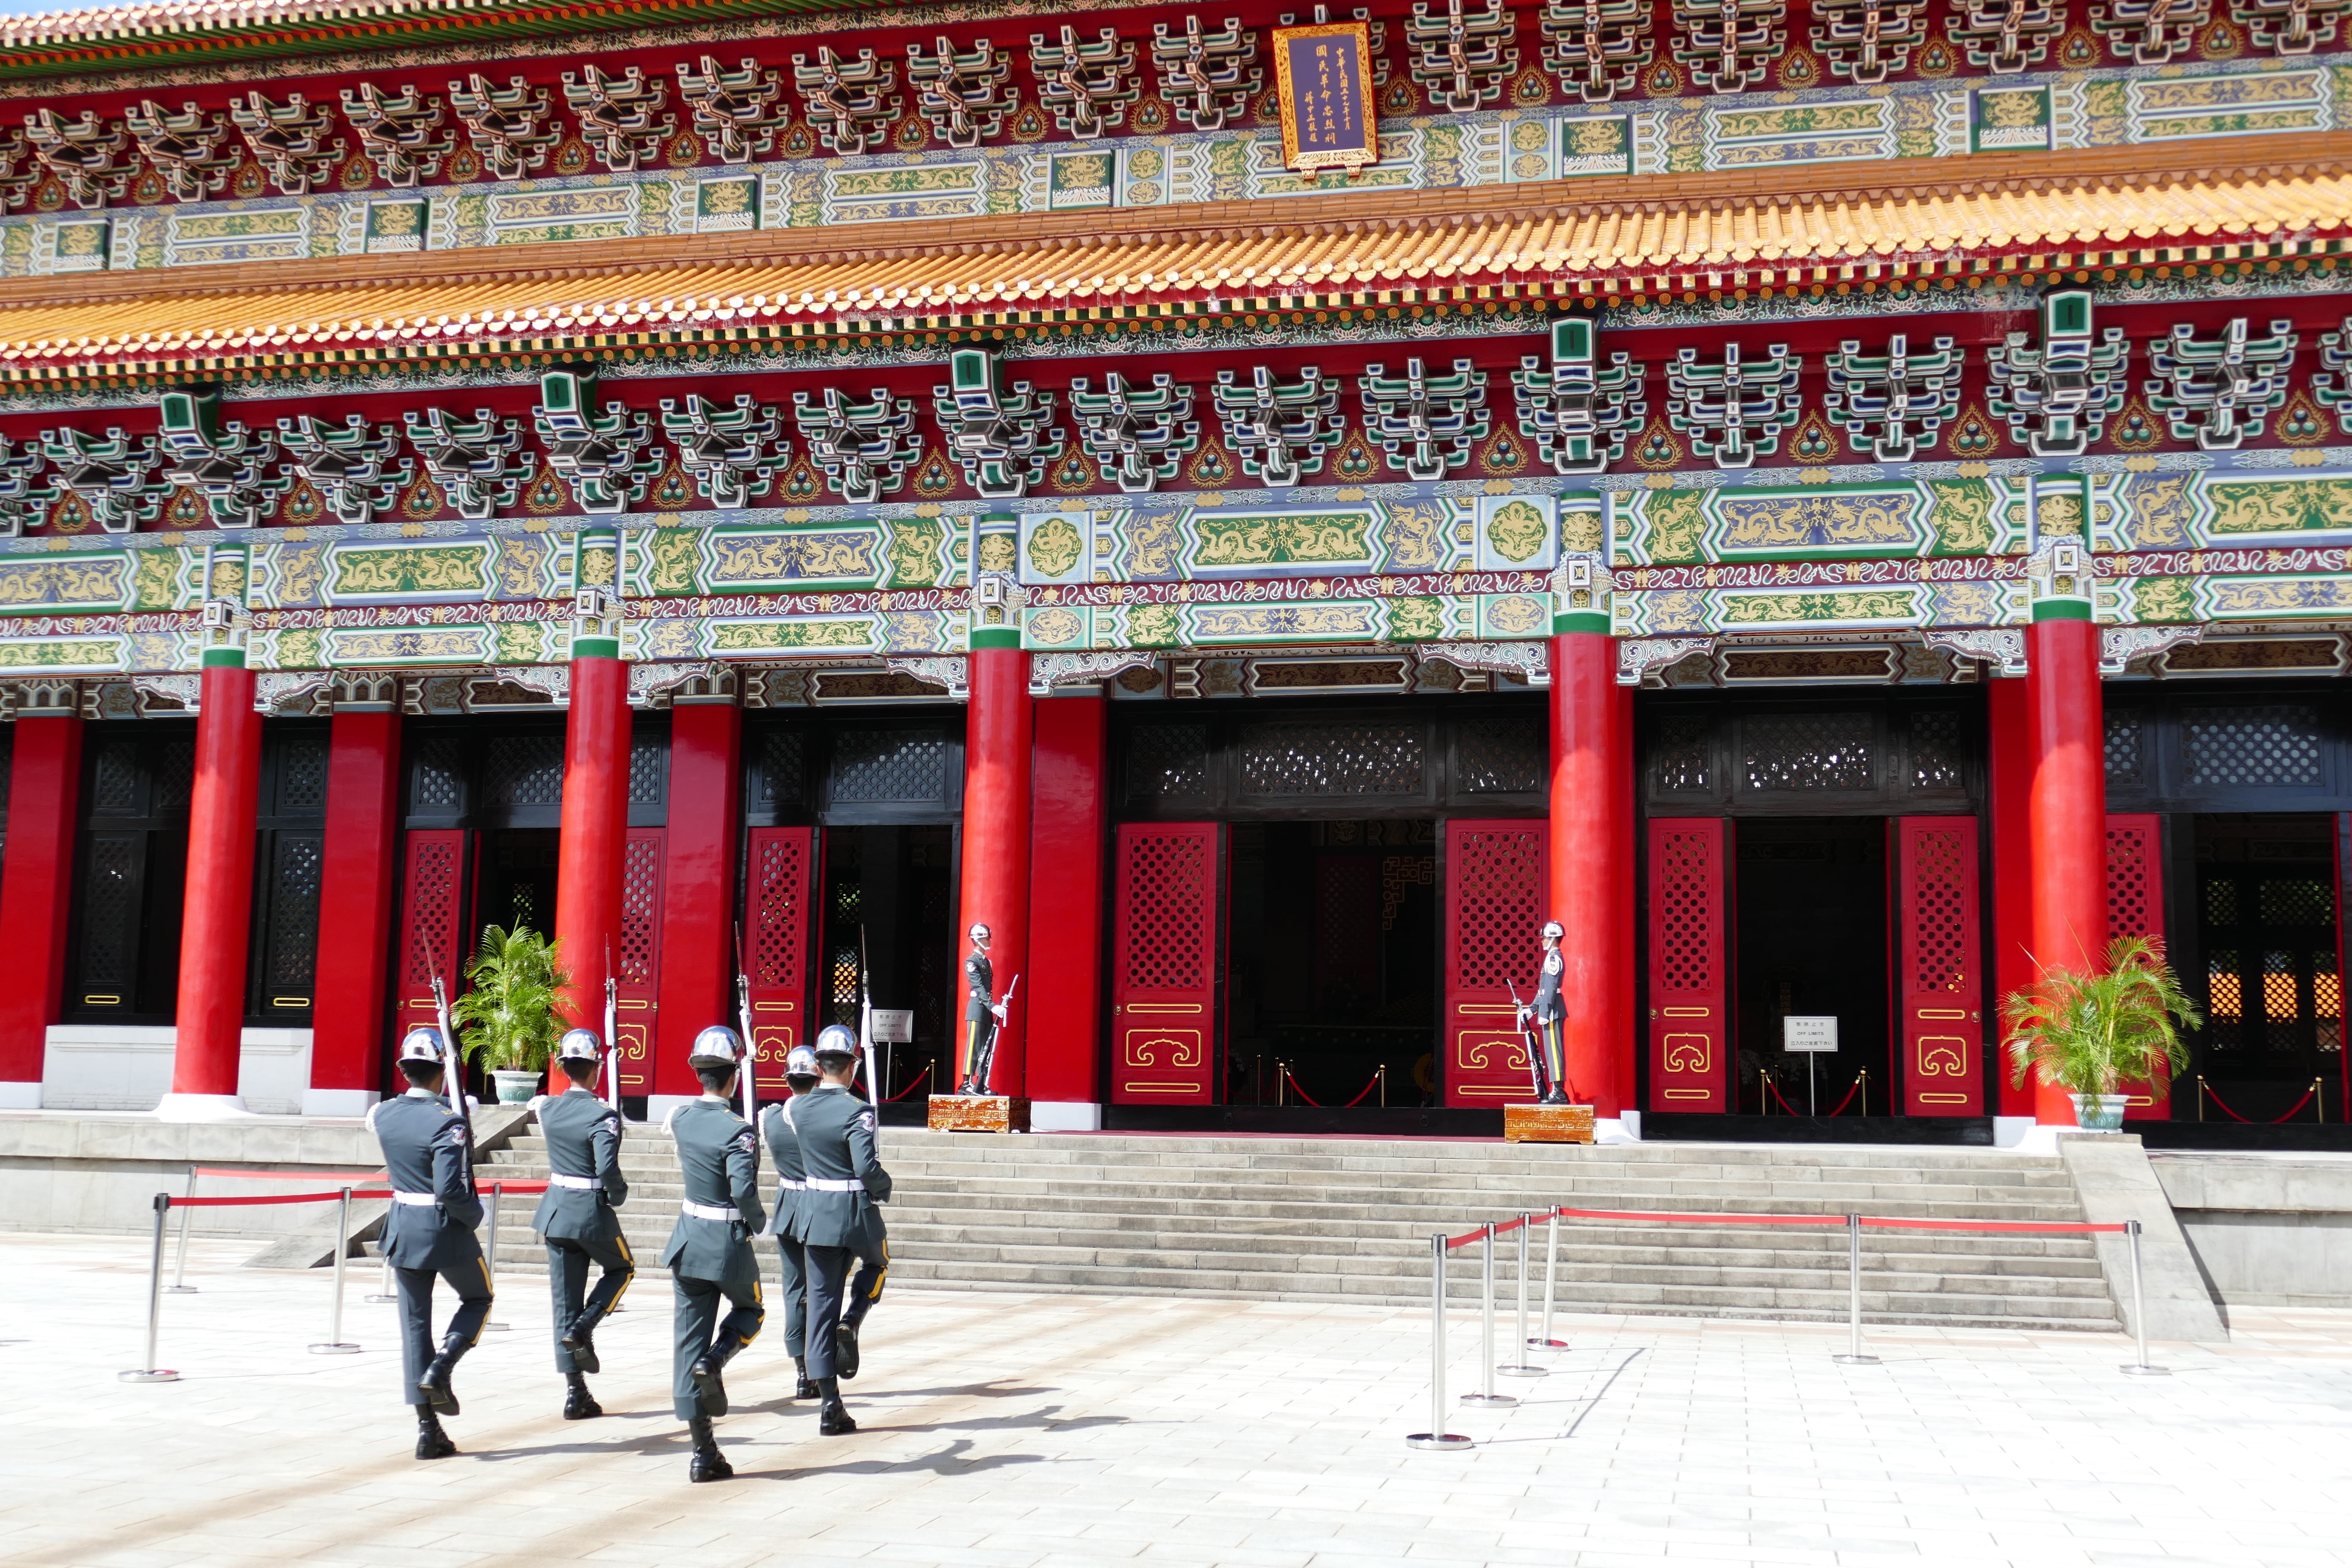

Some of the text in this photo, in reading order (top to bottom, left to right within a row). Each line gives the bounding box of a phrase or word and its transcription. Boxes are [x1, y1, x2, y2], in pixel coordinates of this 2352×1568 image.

[1305, 91, 1317, 142] 蔣中正敬題
[1316, 45, 1336, 144] 國民革命忠烈祠
